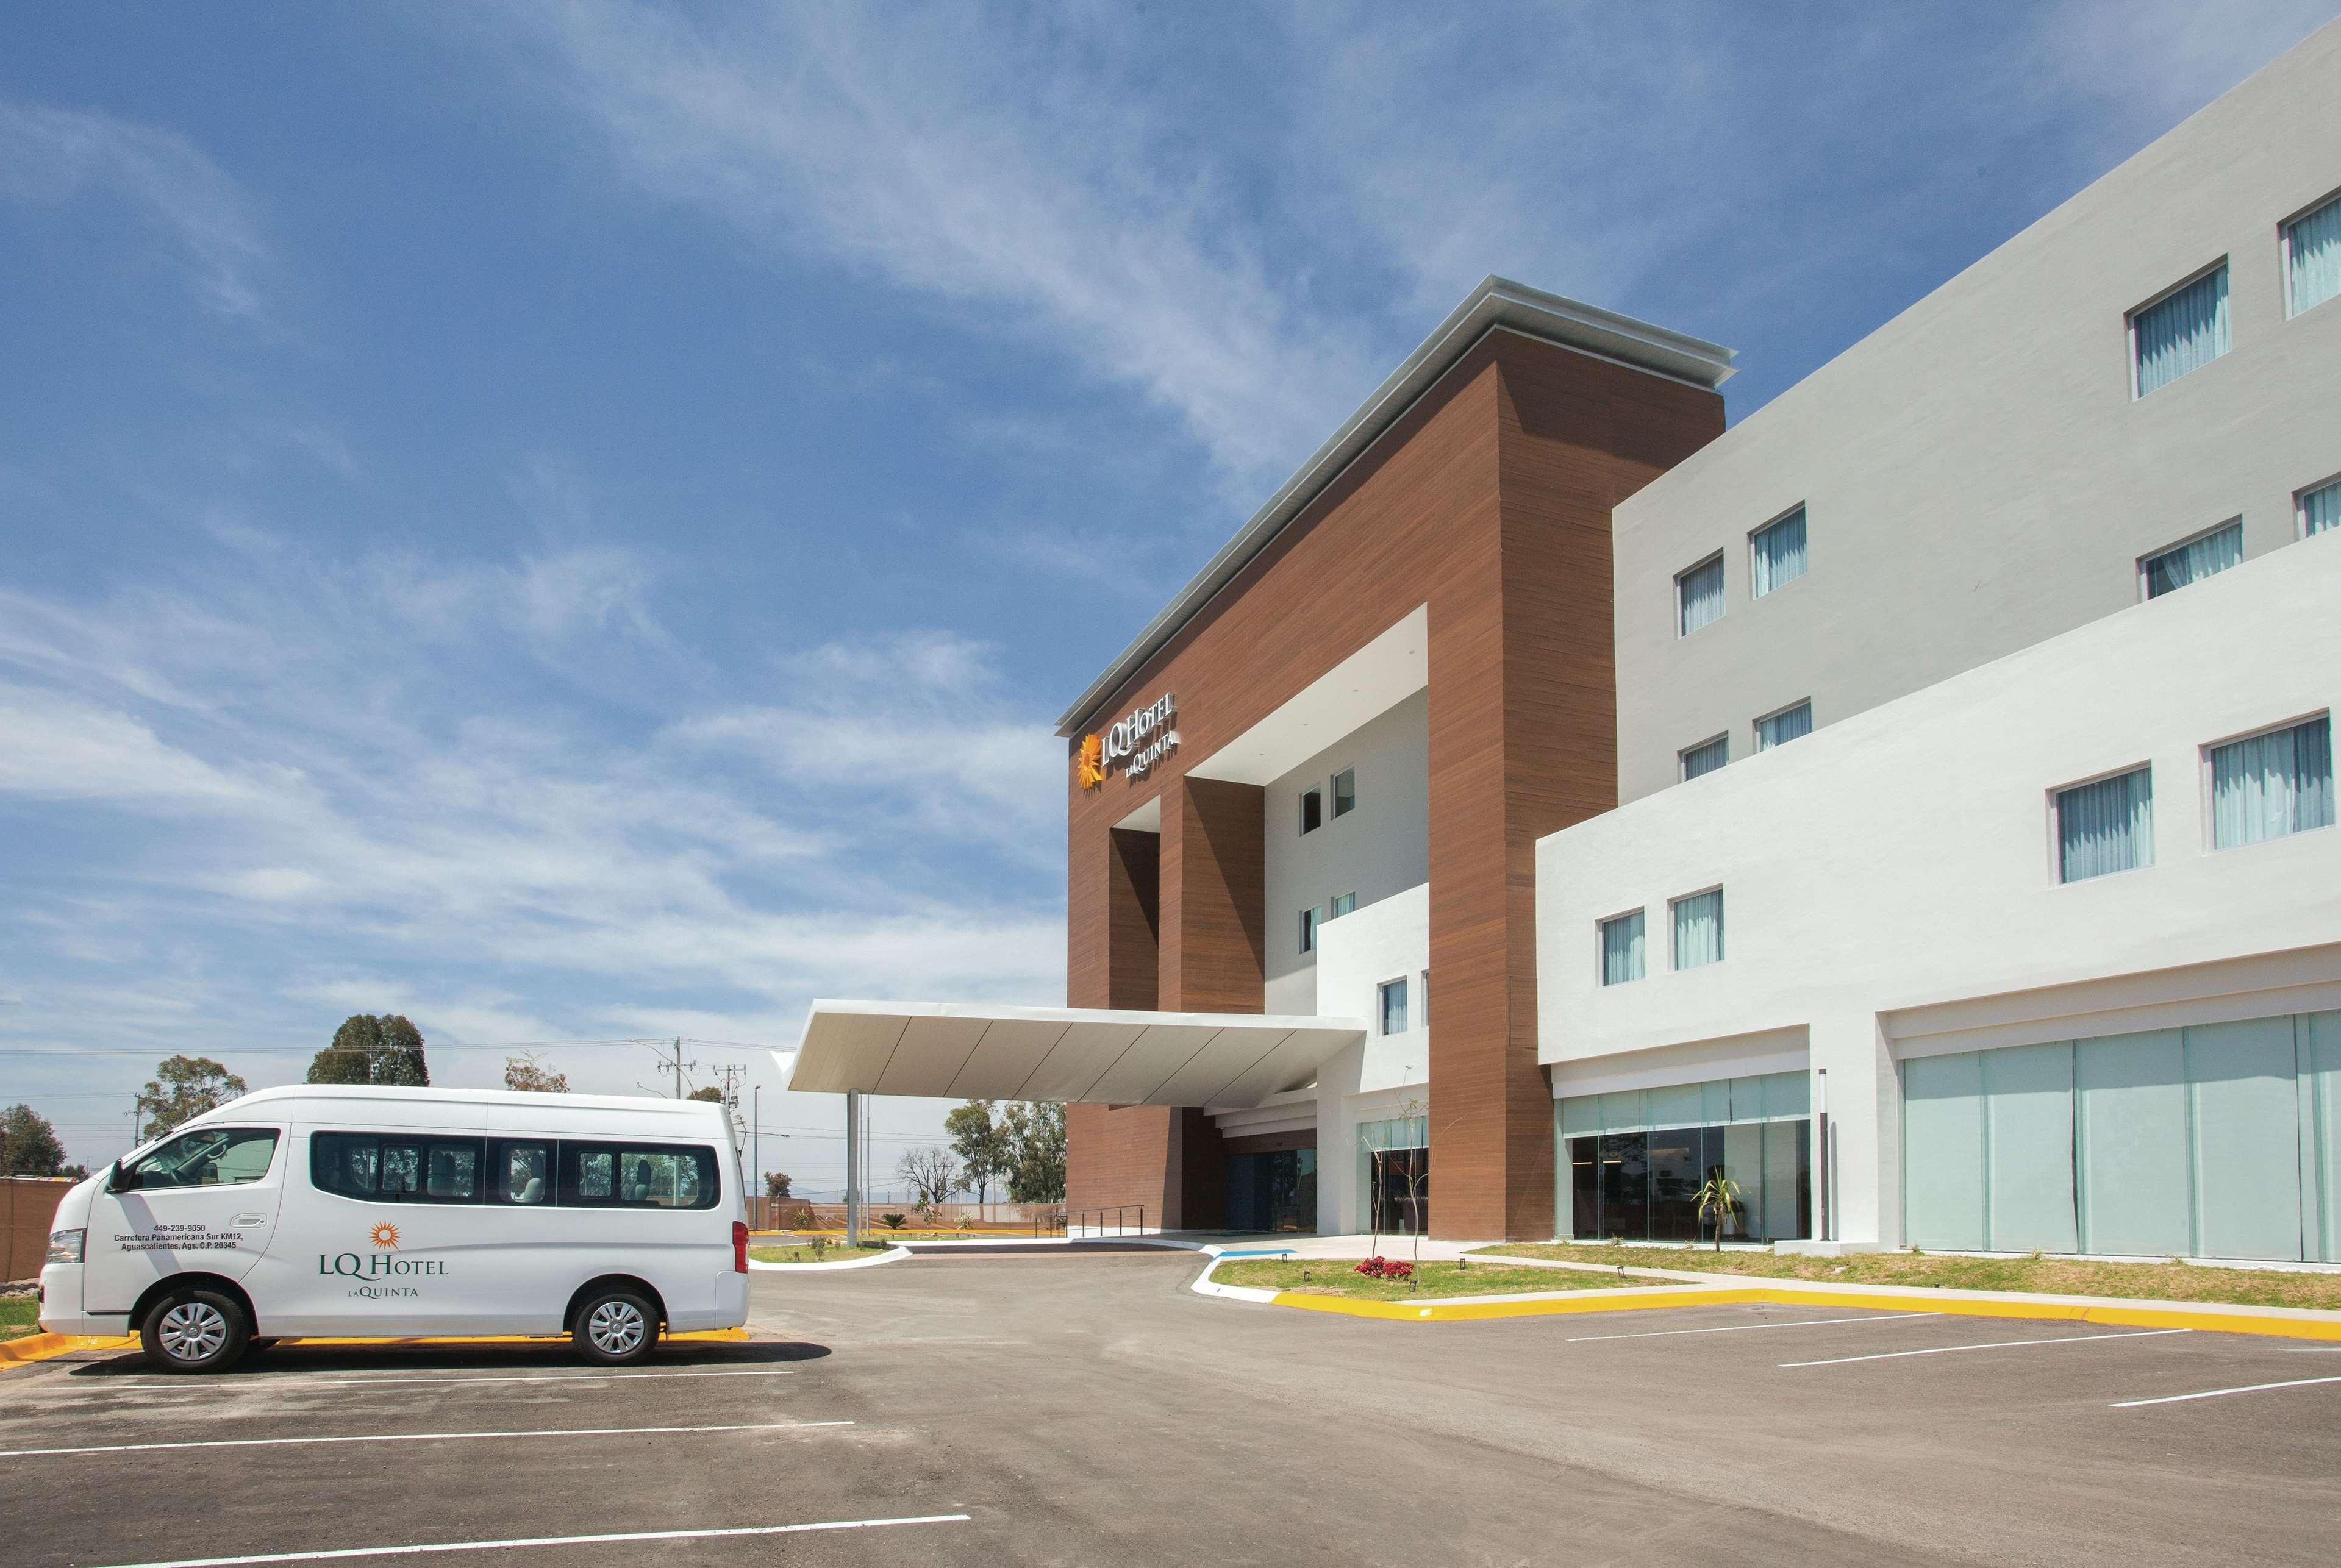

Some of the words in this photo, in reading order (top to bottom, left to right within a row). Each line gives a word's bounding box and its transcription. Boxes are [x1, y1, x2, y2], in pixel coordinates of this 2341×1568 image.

[1102, 722, 1137, 767] LQ
[1133, 730, 1180, 772] QUINTA
[121, 1242, 180, 1251] Aguascalientes,
[182, 1242, 198, 1250] Ags.
[318, 1253, 381, 1281] LQ
[360, 1286, 418, 1299] QUINTA
